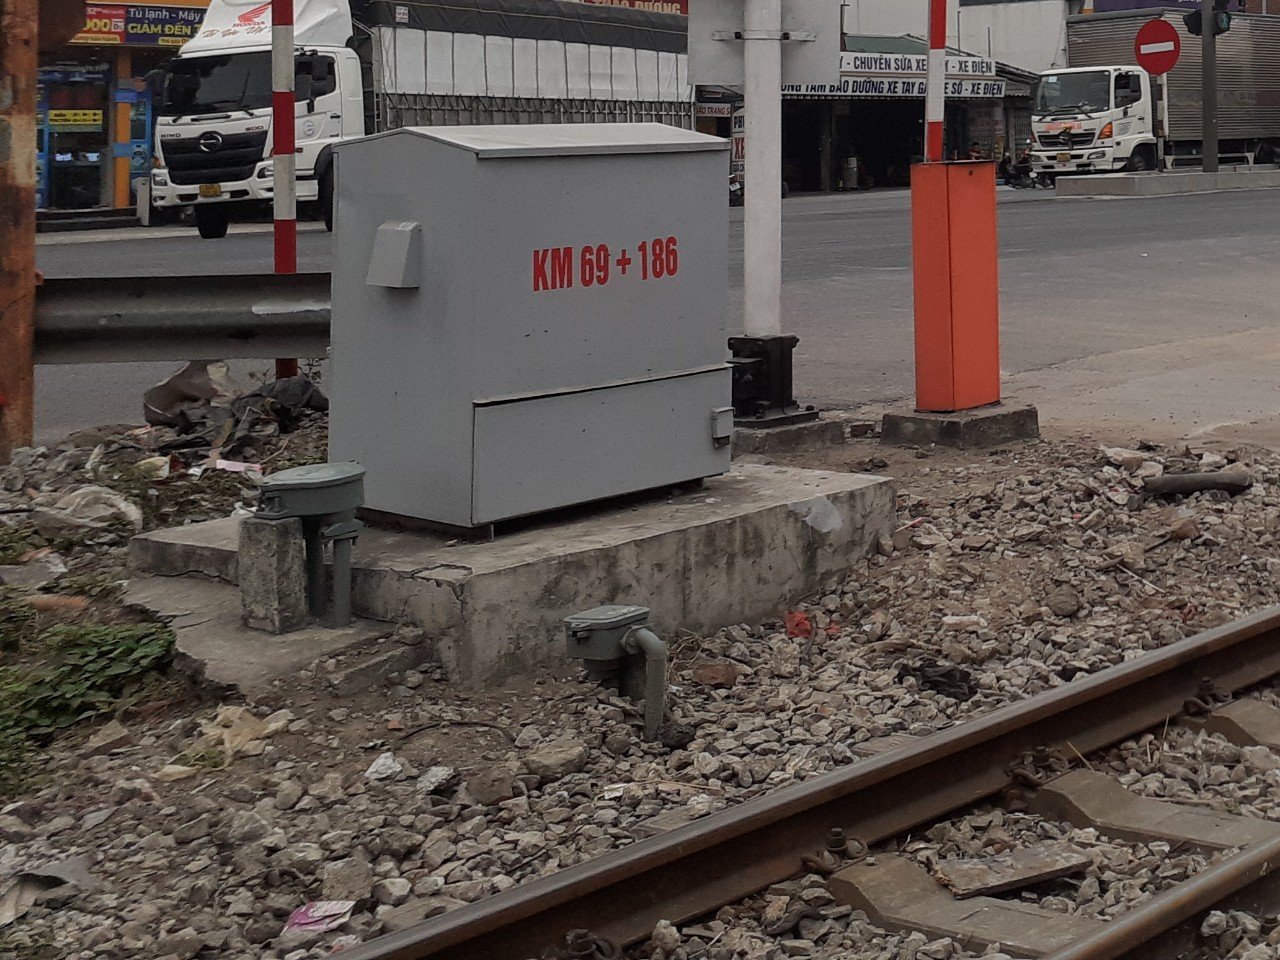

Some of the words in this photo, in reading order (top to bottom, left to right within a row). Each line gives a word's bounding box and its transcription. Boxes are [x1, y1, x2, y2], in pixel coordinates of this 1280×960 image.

[145, 7, 169, 21] lạnh
[179, 10, 201, 23] Máy
[127, 20, 162, 34] GIẢM
[164, 21, 191, 35] ĐẾN
[854, 55, 889, 71] CHUYÊN
[894, 56, 913, 71] SỬA
[916, 58, 927, 71] XE
[958, 60, 969, 72] XE
[972, 59, 992, 75] ĐIỆN
[852, 77, 884, 94] DƯỠNG
[887, 81, 898, 94] XE
[901, 81, 917, 94] TAY
[952, 80, 963, 95] SỐ
[970, 82, 981, 95] XE
[984, 81, 1003, 98] ĐIỆN
[707, 106, 726, 115] TRANG
[533, 247, 573, 291] KM
